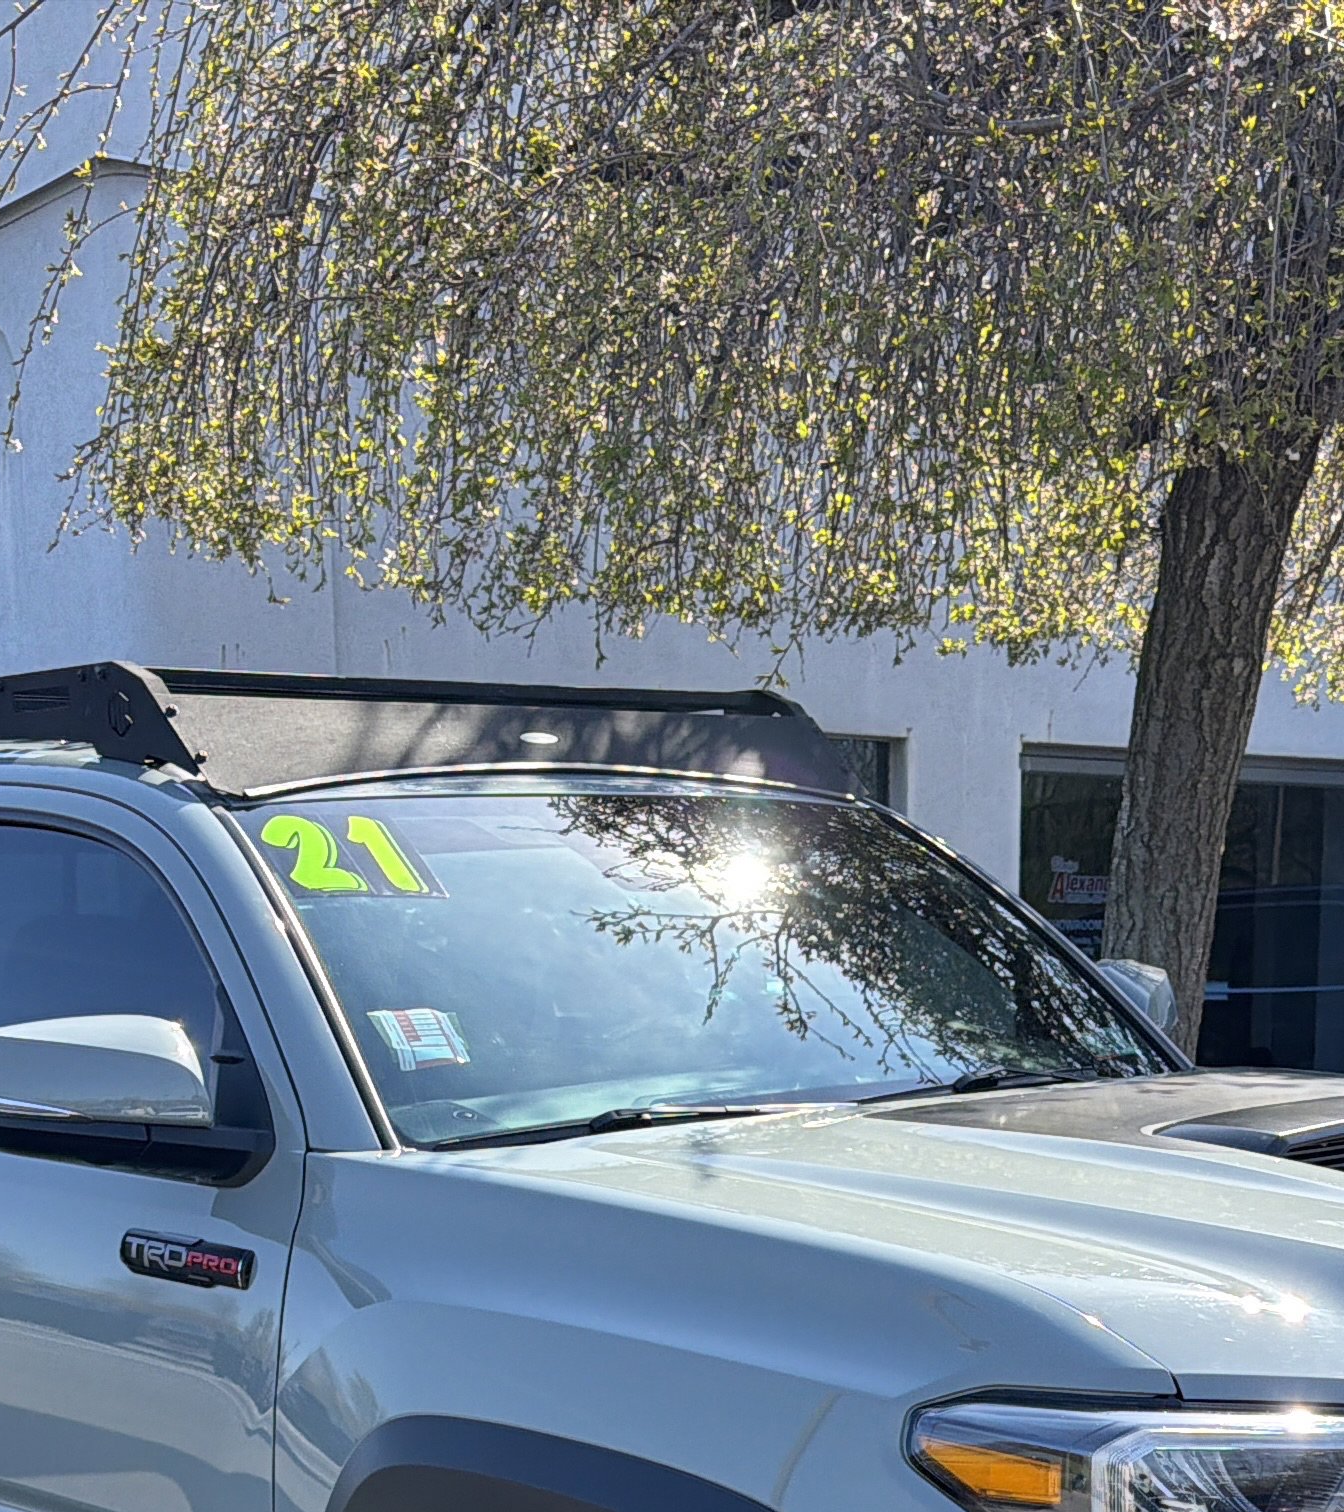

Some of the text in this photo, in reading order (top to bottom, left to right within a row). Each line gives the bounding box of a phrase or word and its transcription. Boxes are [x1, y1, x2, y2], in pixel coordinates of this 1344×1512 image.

[260, 814, 430, 893] 21
[124, 1235, 238, 1275] TRD PRO
